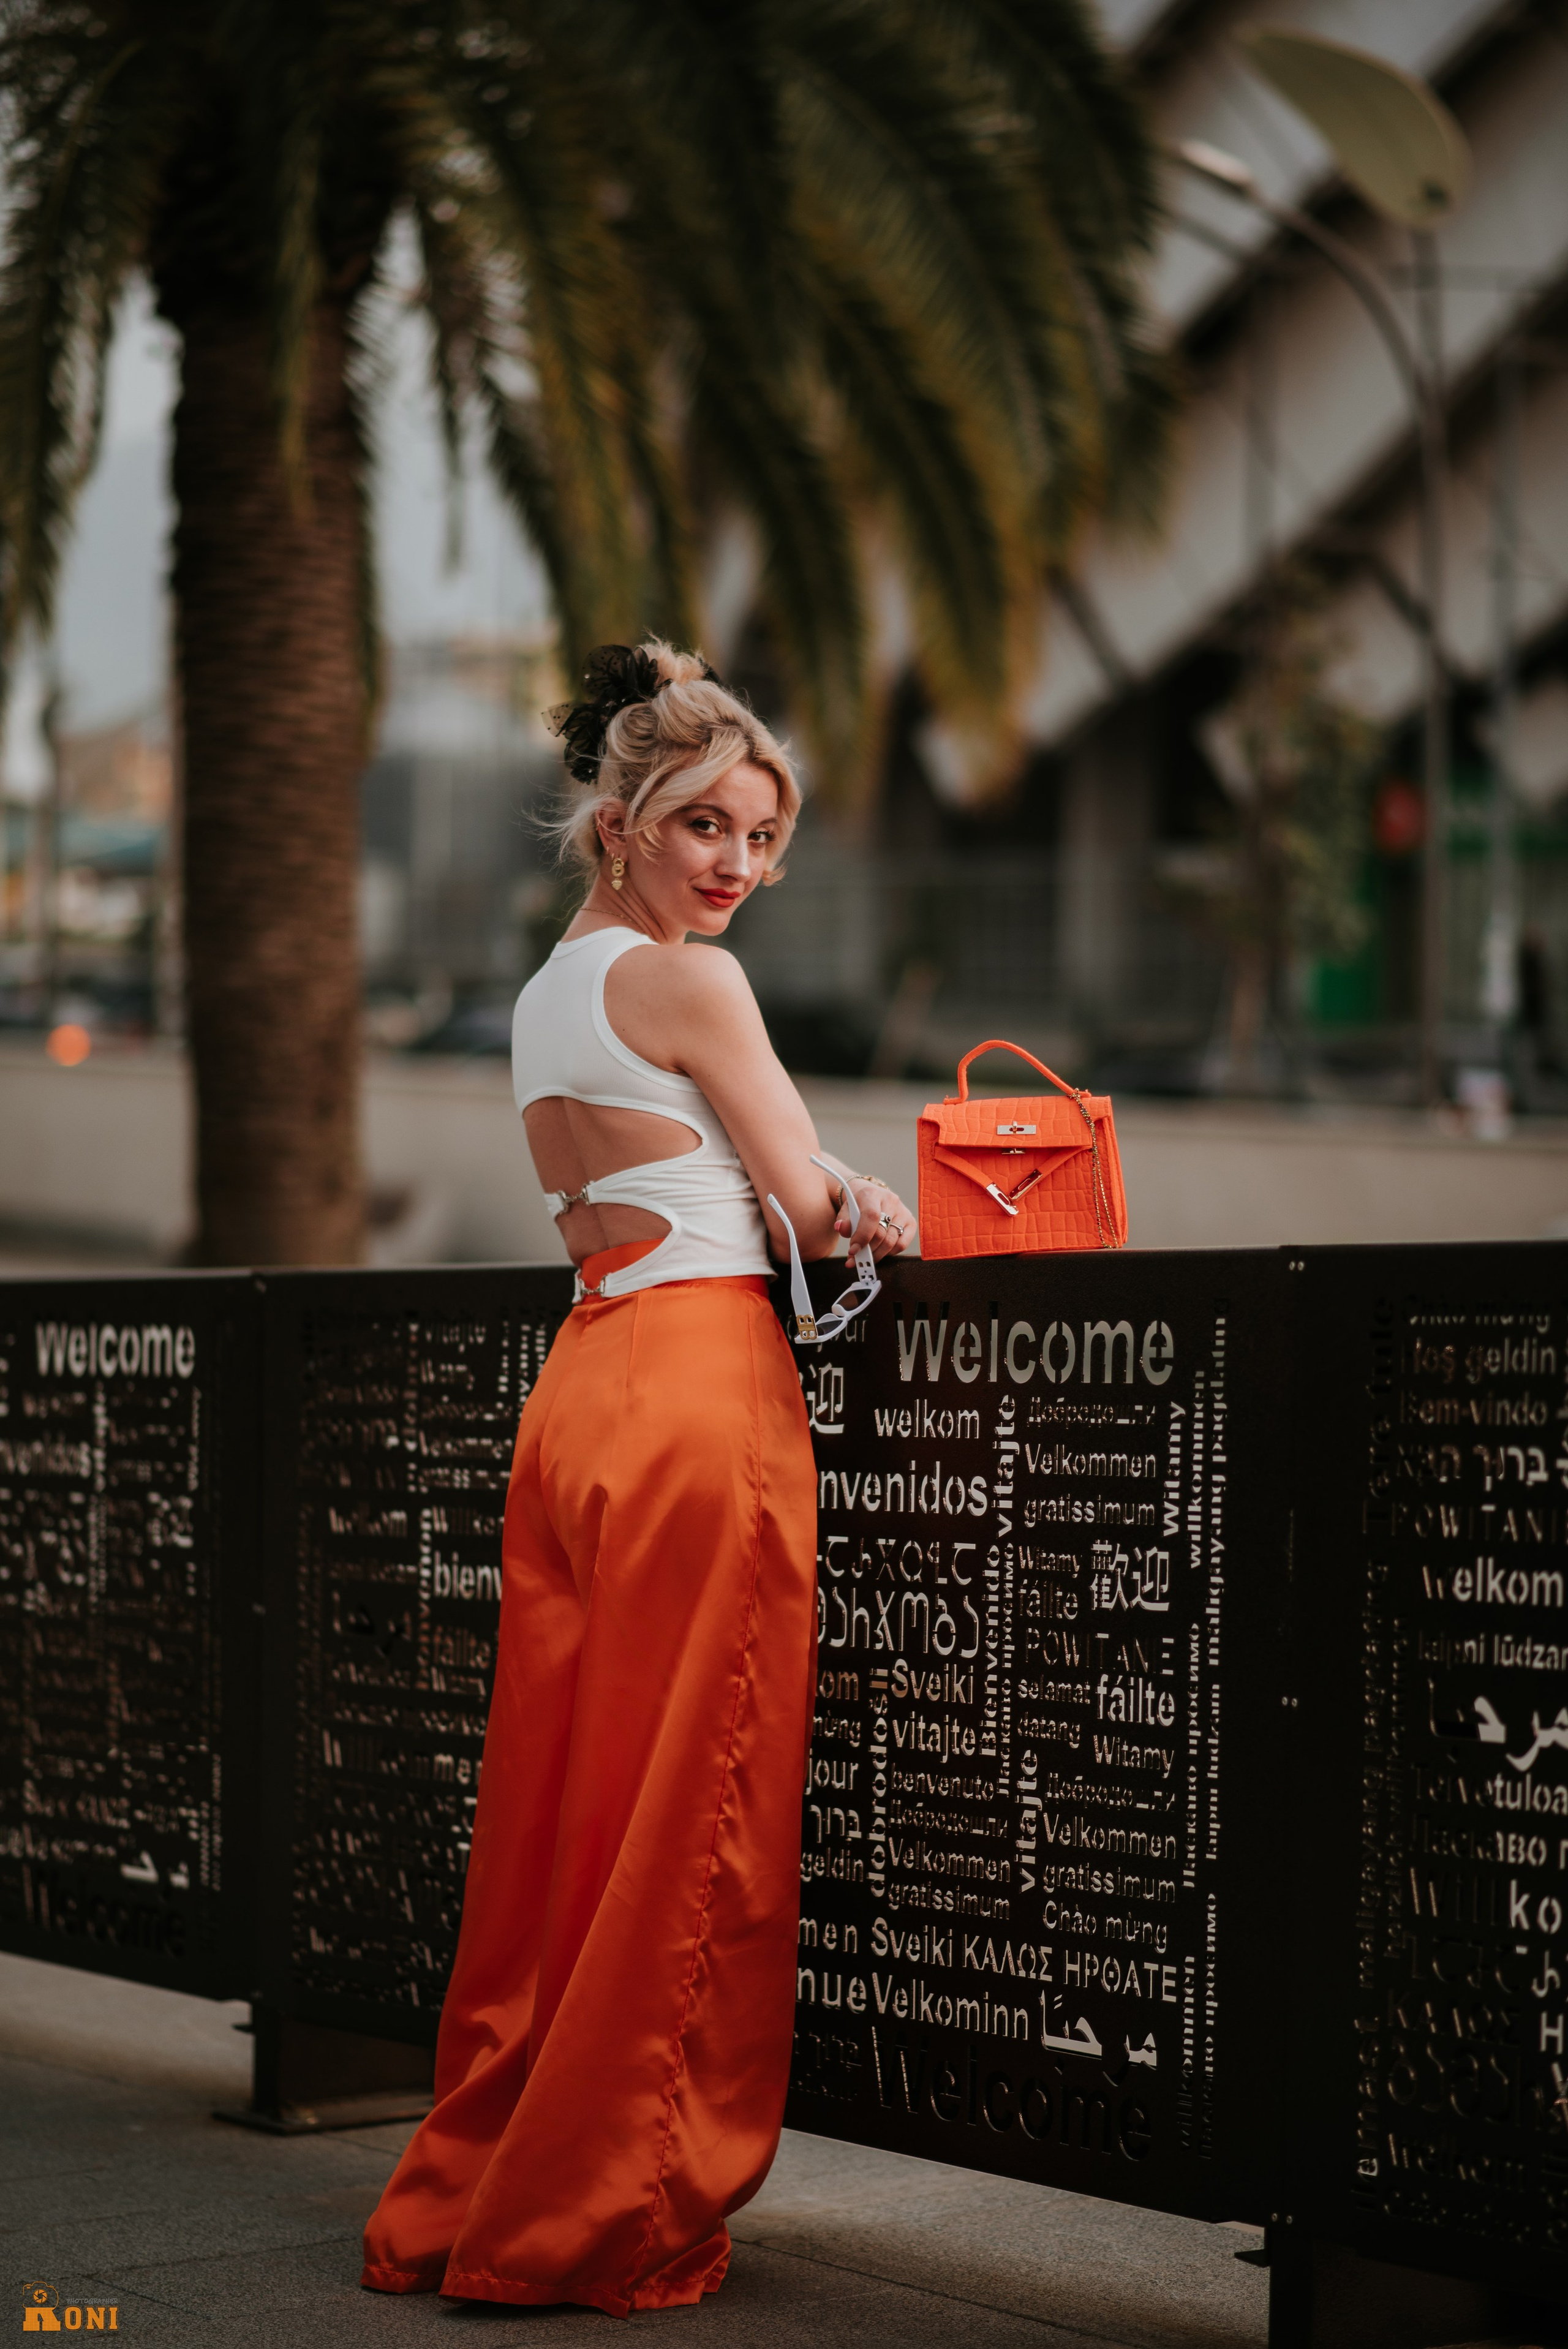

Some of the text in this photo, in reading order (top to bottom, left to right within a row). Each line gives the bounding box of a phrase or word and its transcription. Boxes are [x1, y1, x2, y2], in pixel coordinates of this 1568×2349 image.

[35, 1320, 196, 1379] Welcome
[894, 1300, 1175, 1386] Welcome
[798, 1362, 845, 1435] 迎
[874, 1399, 979, 1439] welkom
[991, 1394, 1020, 1537] vitajte
[1024, 1442, 1156, 1479] Velkommen
[1161, 1400, 1187, 1538] Witamy
[1023, 1492, 1156, 1528] gratissimum
[1018, 1544, 1084, 1579] Witamy
[1018, 1577, 1079, 1621] fáilte
[815, 1668, 859, 1702] om
[891, 1658, 974, 1705] Sveiki
[1095, 1673, 1176, 1728] fáilte
[891, 1710, 976, 1764] vitajte
[1093, 1734, 1175, 1779] Witamy
[804, 1747, 860, 1797] jour
[865, 1667, 889, 1900] dobrodošli
[891, 1761, 995, 1803] benvenuto
[1014, 1749, 1044, 1895] vitajte
[1042, 1811, 1177, 1860] Velkommen
[800, 1846, 864, 1884] geldin
[888, 1836, 1011, 1884] Velkommen
[1042, 1862, 1176, 1904] gratissimum
[888, 1880, 1010, 1921] gratissimum
[1042, 1899, 1097, 1936] Chào
[870, 1916, 953, 1969] Sveiki
[795, 1966, 867, 2015] nue
[870, 1971, 1031, 2042] Velkominn
